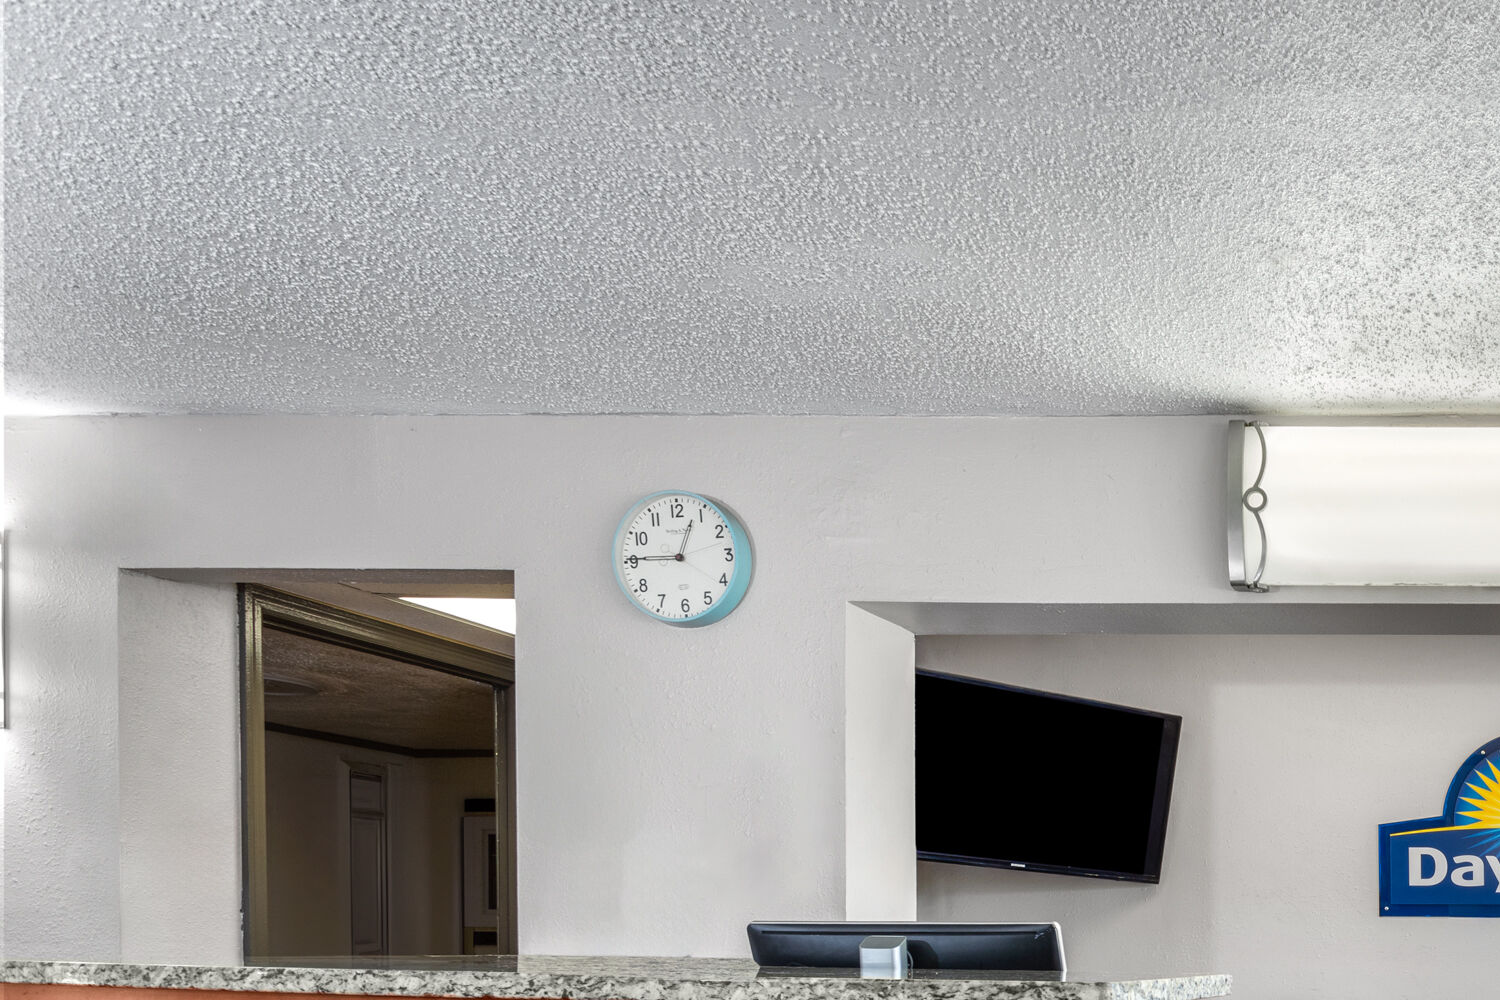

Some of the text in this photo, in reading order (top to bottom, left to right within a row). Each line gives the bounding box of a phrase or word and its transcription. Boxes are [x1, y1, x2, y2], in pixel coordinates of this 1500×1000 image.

[670, 503, 684, 518] 12
[699, 508, 703, 523] 1
[651, 512, 660, 527] 11
[634, 531, 648, 546] 10
[715, 524, 725, 539] 2
[628, 554, 639, 569] 9
[723, 547, 734, 562] 3
[639, 578, 648, 593] 8
[719, 572, 729, 587] 4
[657, 594, 666, 608] 7
[680, 598, 691, 613] 6
[703, 591, 713, 605] 5
